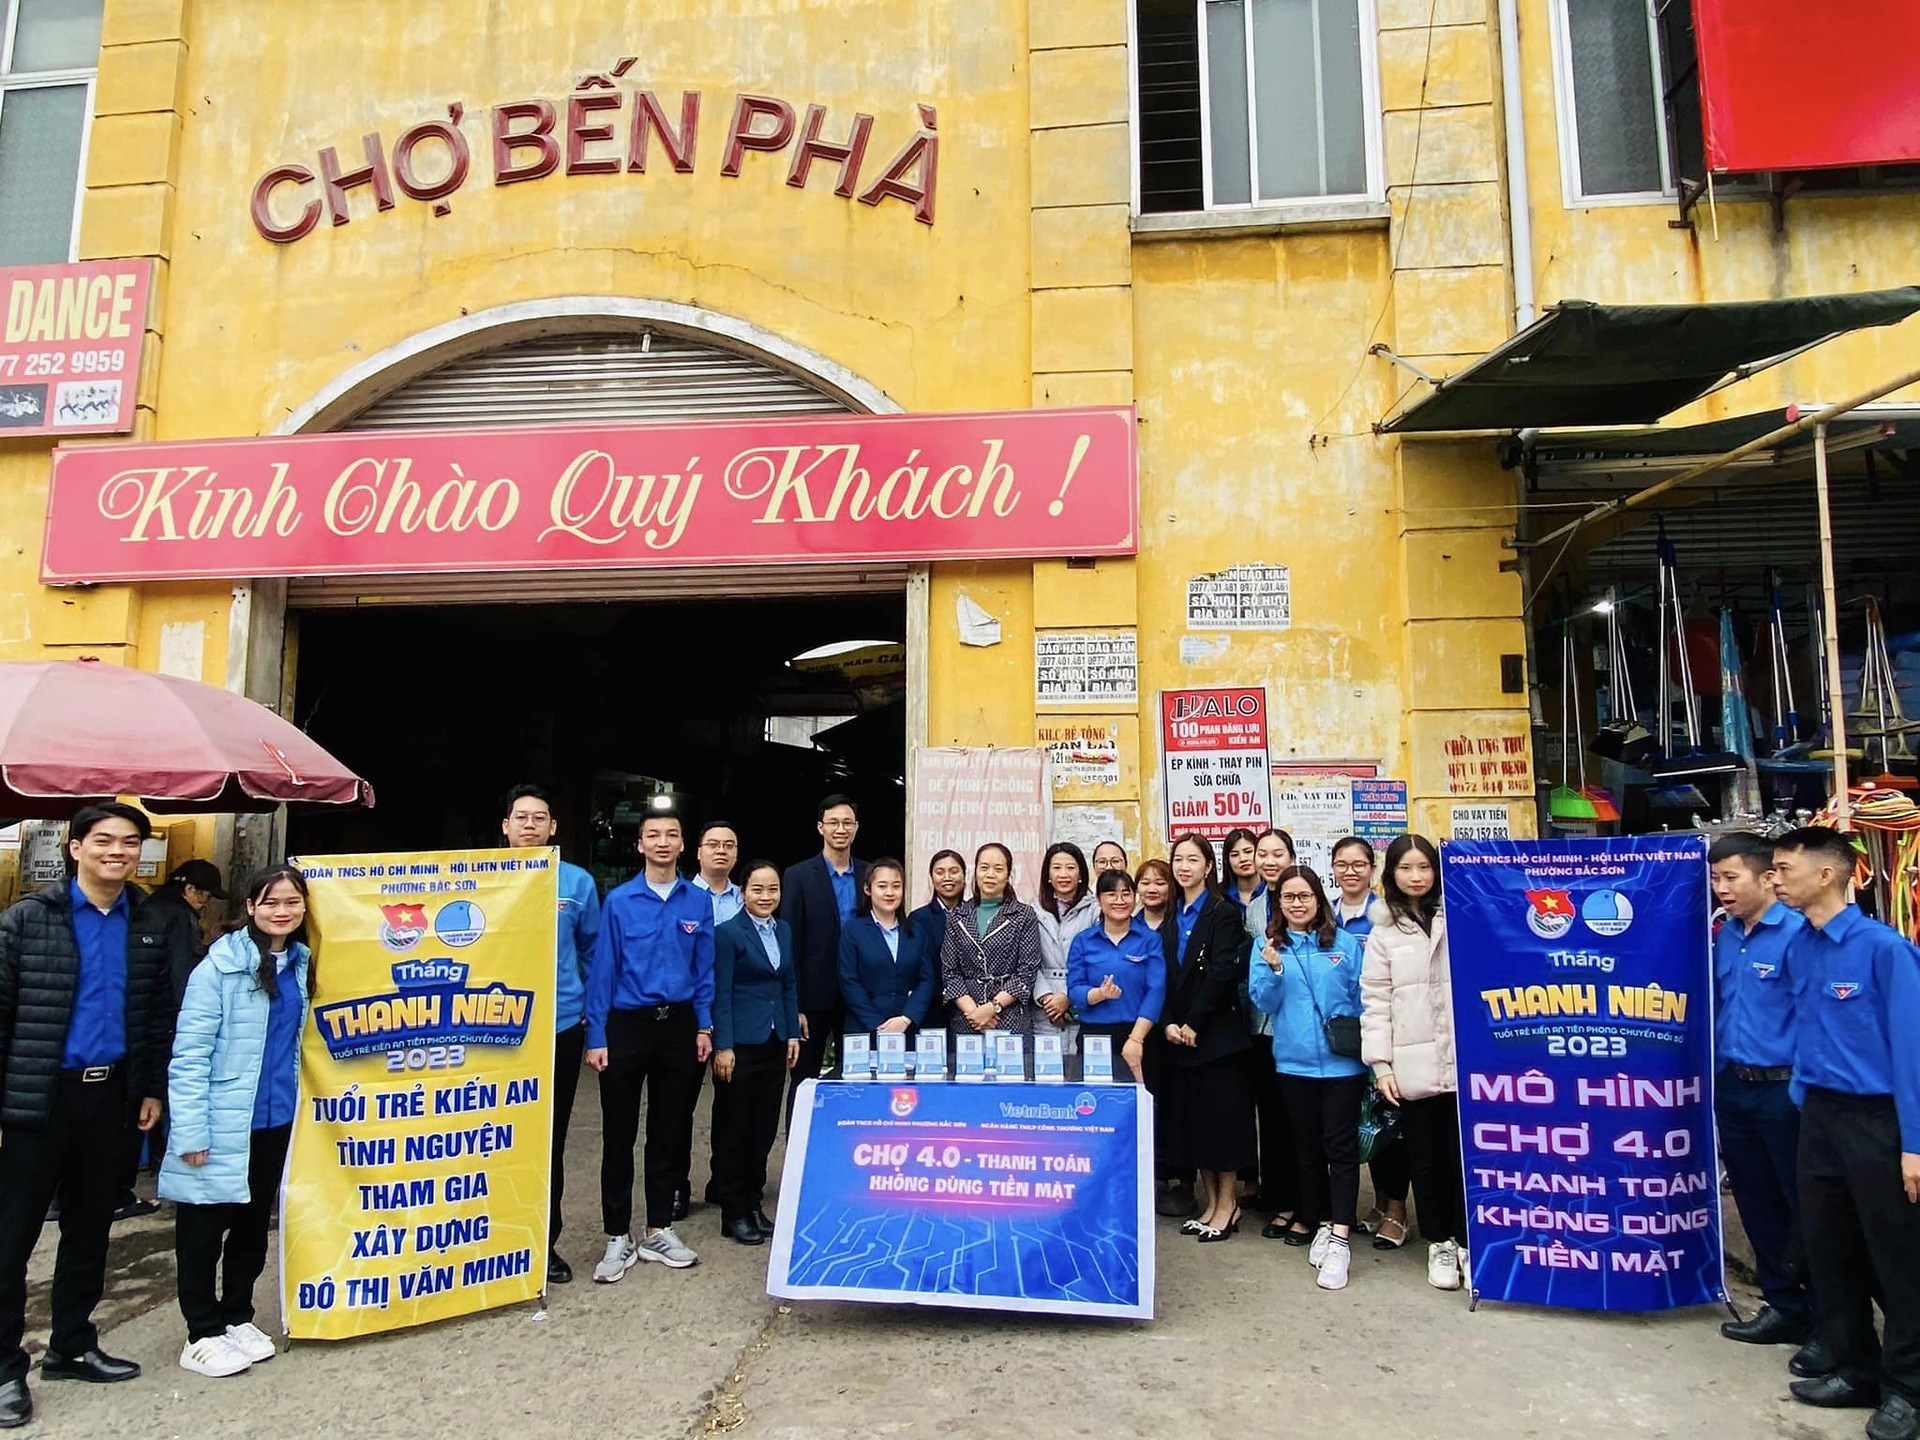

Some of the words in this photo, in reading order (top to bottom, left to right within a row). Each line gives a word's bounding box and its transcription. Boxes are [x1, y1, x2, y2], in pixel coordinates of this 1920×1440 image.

[250, 102, 471, 243] CHỢ
[493, 56, 702, 186] BẾN
[720, 103, 938, 225] PHÀ
[5, 273, 137, 343] DANCE
[24, 352, 66, 376] 252
[70, 349, 125, 374] 9959
[98, 462, 302, 542] Kính
[323, 456, 520, 536] Chào
[537, 449, 704, 550] Quý
[723, 439, 1020, 523] Khách
[1047, 434, 1091, 517] !
[1170, 722, 1199, 738] 100
[1187, 756, 1209, 770] KÍNH
[1219, 757, 1243, 769] THAY
[1246, 757, 1262, 769] PIN
[1172, 796, 1208, 817] GIẢM
[1214, 791, 1261, 816] 50%
[1471, 810, 1488, 820] VAY
[337, 867, 365, 877] TNCS
[411, 863, 438, 875] MINH
[471, 861, 497, 872] LHTN
[525, 860, 548, 869] NAM
[1481, 855, 1511, 864] TNCS
[1531, 853, 1550, 863] CHÍ
[1553, 854, 1582, 863] MINH
[1591, 852, 1611, 864] HỘI
[1614, 853, 1643, 862] LHTN
[1645, 850, 1671, 863] VIỆT
[1674, 851, 1700, 860] NAM
[1602, 865, 1625, 875] SƠN
[396, 962, 464, 982] Tháng
[1549, 951, 1615, 971] Tháng
[322, 994, 440, 1040] THANH
[451, 986, 528, 1027] NIÊN
[1481, 985, 1597, 1021] THANH
[1608, 982, 1688, 1024] NIÊN
[387, 1045, 465, 1072] 2023
[1548, 1036, 1627, 1057] 2023
[312, 1083, 365, 1122] TUỔI
[376, 1084, 424, 1119] TRẺ
[435, 1077, 496, 1115] KIẾN
[505, 1077, 538, 1106] AN
[1470, 1069, 1555, 1104] MÔ
[1577, 1073, 1700, 1107] HÌNH
[1000, 1102, 1079, 1120] VietinBank
[337, 1137, 395, 1166] TÌNH
[405, 1123, 512, 1162] NGUYỆN
[1473, 1122, 1590, 1162] CHỢ
[1614, 1129, 1691, 1158] 4.0
[854, 1143, 910, 1172] CHỢ
[917, 1146, 960, 1168] 4.0
[977, 1153, 1037, 1171] THANH
[1042, 1153, 1091, 1173] TOÁN
[359, 1179, 434, 1210] THAM
[445, 1172, 488, 1202] GIA
[869, 1173, 929, 1194] KHÔNG
[935, 1176, 983, 1195] DÙNG
[989, 1174, 1029, 1197] TIỀN
[1036, 1183, 1075, 1203] MẶT
[1474, 1168, 1606, 1196] THANH
[1619, 1171, 1708, 1198] TOÁN
[1477, 1204, 1609, 1233] KHÔNG
[1622, 1208, 1708, 1235] DÙNG
[351, 1224, 407, 1258] XÂY
[416, 1216, 489, 1255] DỰNG
[1515, 1239, 1599, 1270] TIỀN
[1611, 1249, 1685, 1277] MẶT
[298, 1277, 335, 1309] ĐÔ
[346, 1277, 389, 1309] THỊ
[400, 1265, 454, 1299] VĂN
[462, 1248, 530, 1286] MINH
